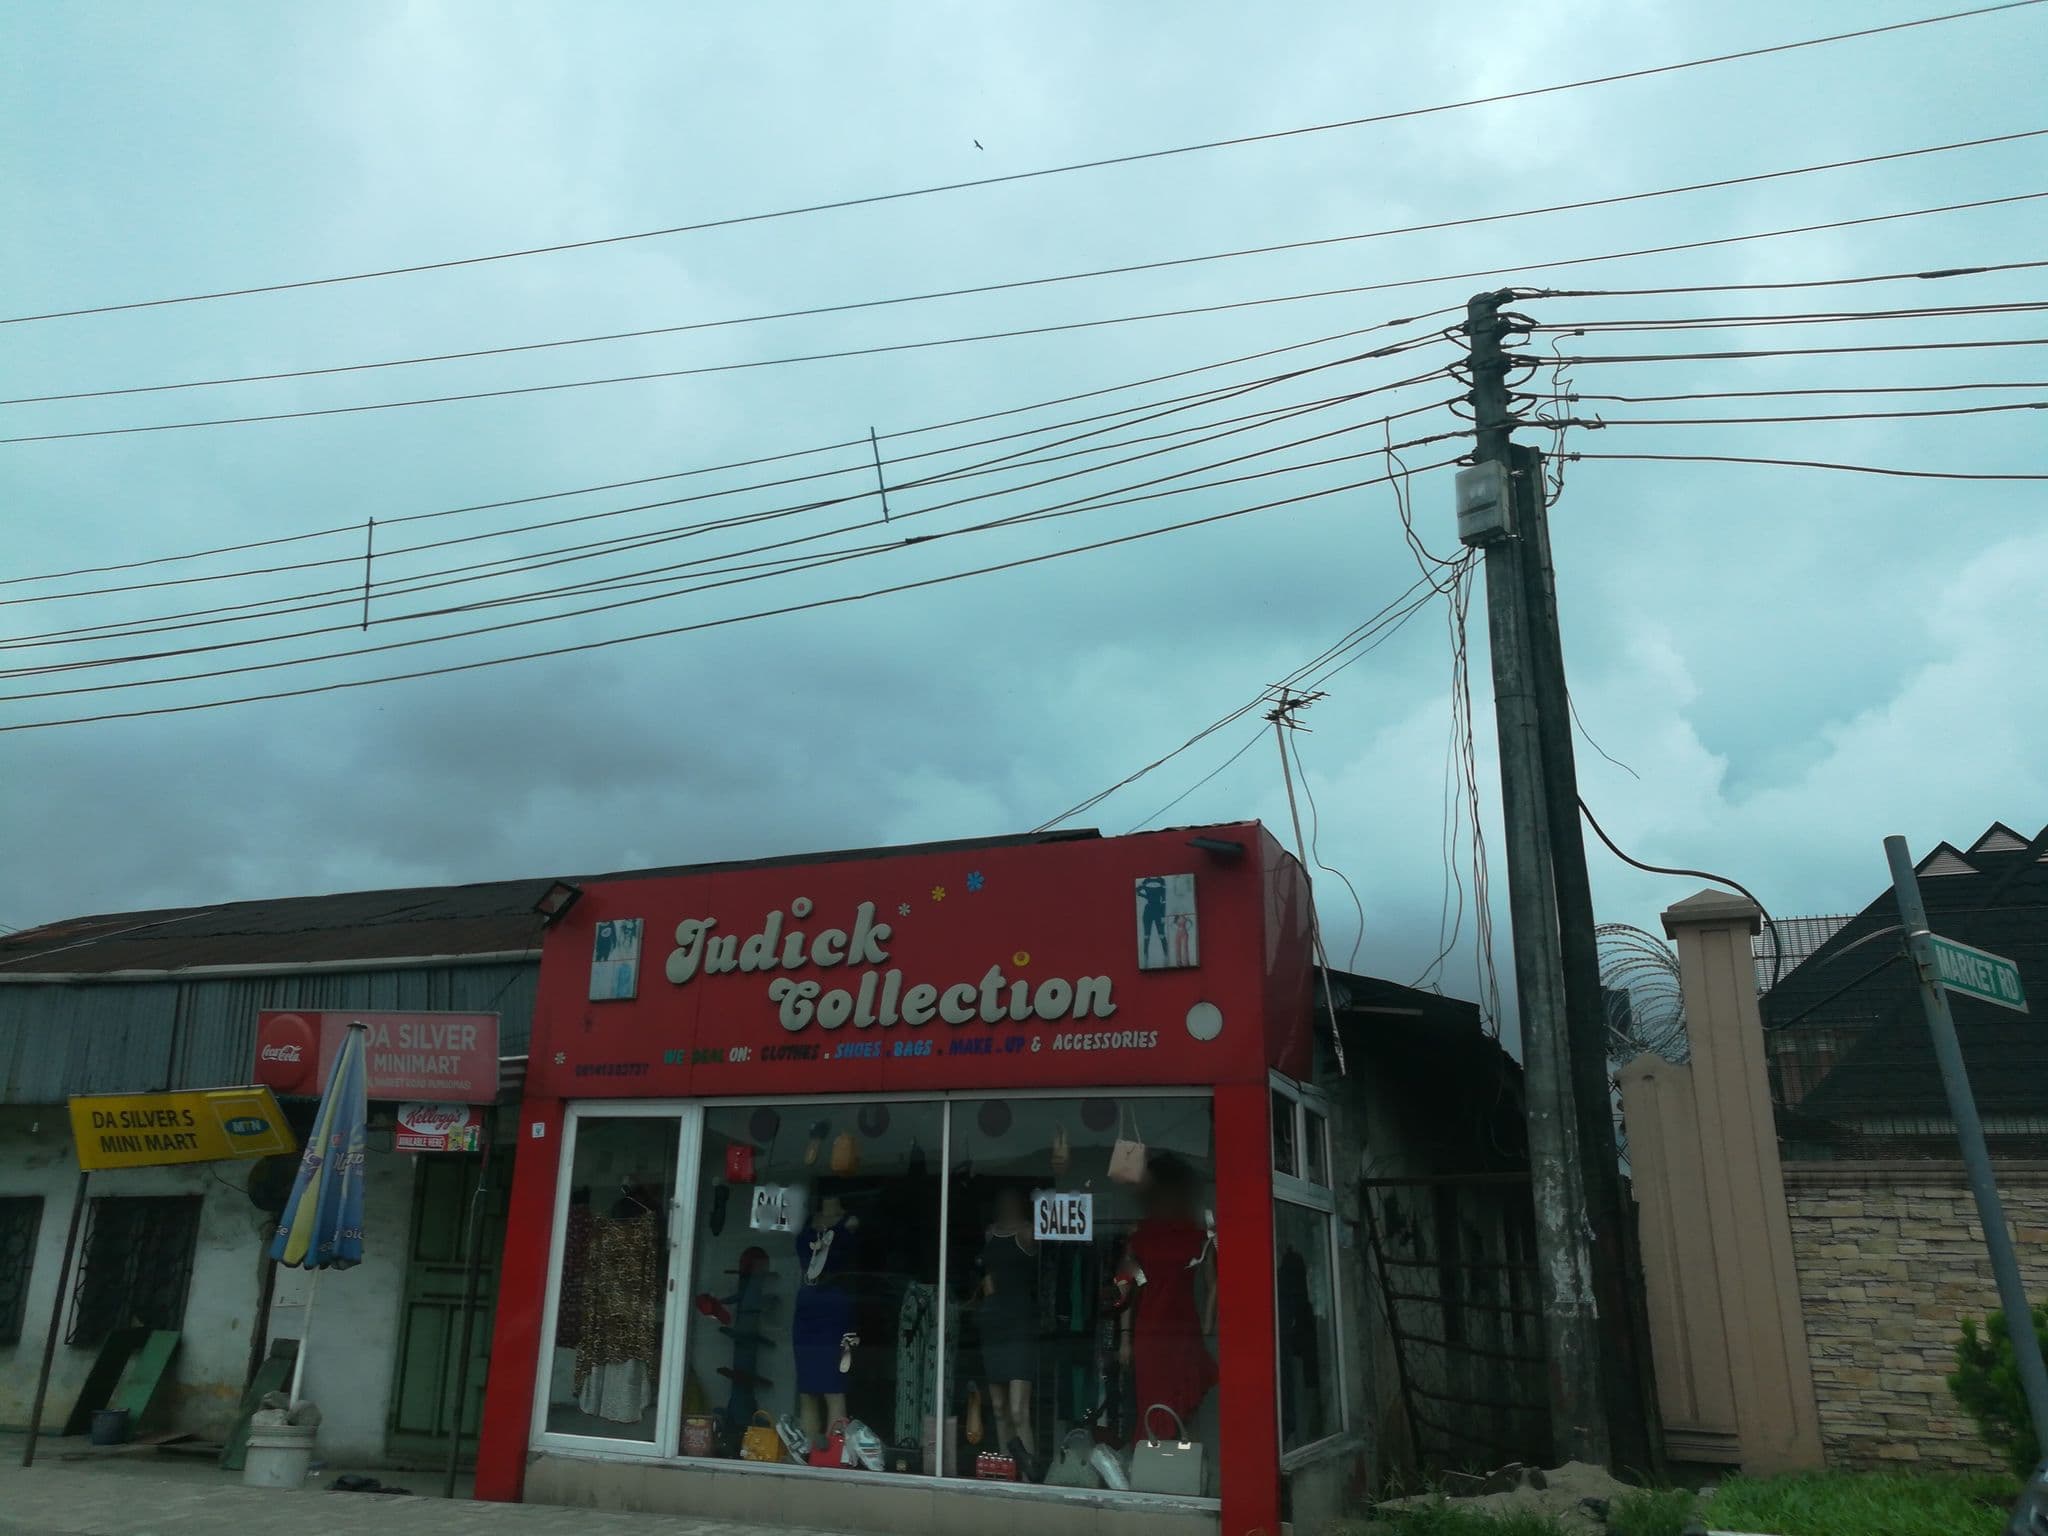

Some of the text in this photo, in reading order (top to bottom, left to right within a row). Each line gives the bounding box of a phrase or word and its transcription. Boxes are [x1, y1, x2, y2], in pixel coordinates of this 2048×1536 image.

[1935, 944, 2020, 1000] MARKET RD
[769, 964, 1118, 1032] Collection
[399, 1023, 477, 1051] SILVER
[664, 1049, 685, 1065] WE
[729, 1045, 752, 1062] ON:
[761, 1044, 820, 1061] CLOTHES
[834, 1041, 882, 1059] SHOES
[894, 1039, 933, 1057] BAGS
[949, 1037, 992, 1055] MAKE
[1031, 1036, 1042, 1052] &
[1053, 1031, 1158, 1051] ACCESSORIES
[374, 1054, 461, 1074] MINIMART
[92, 1110, 118, 1129] DA
[232, 1119, 262, 1132] MTN
[100, 1133, 199, 1153] MINI MART
[1039, 1195, 1087, 1236] SALES
